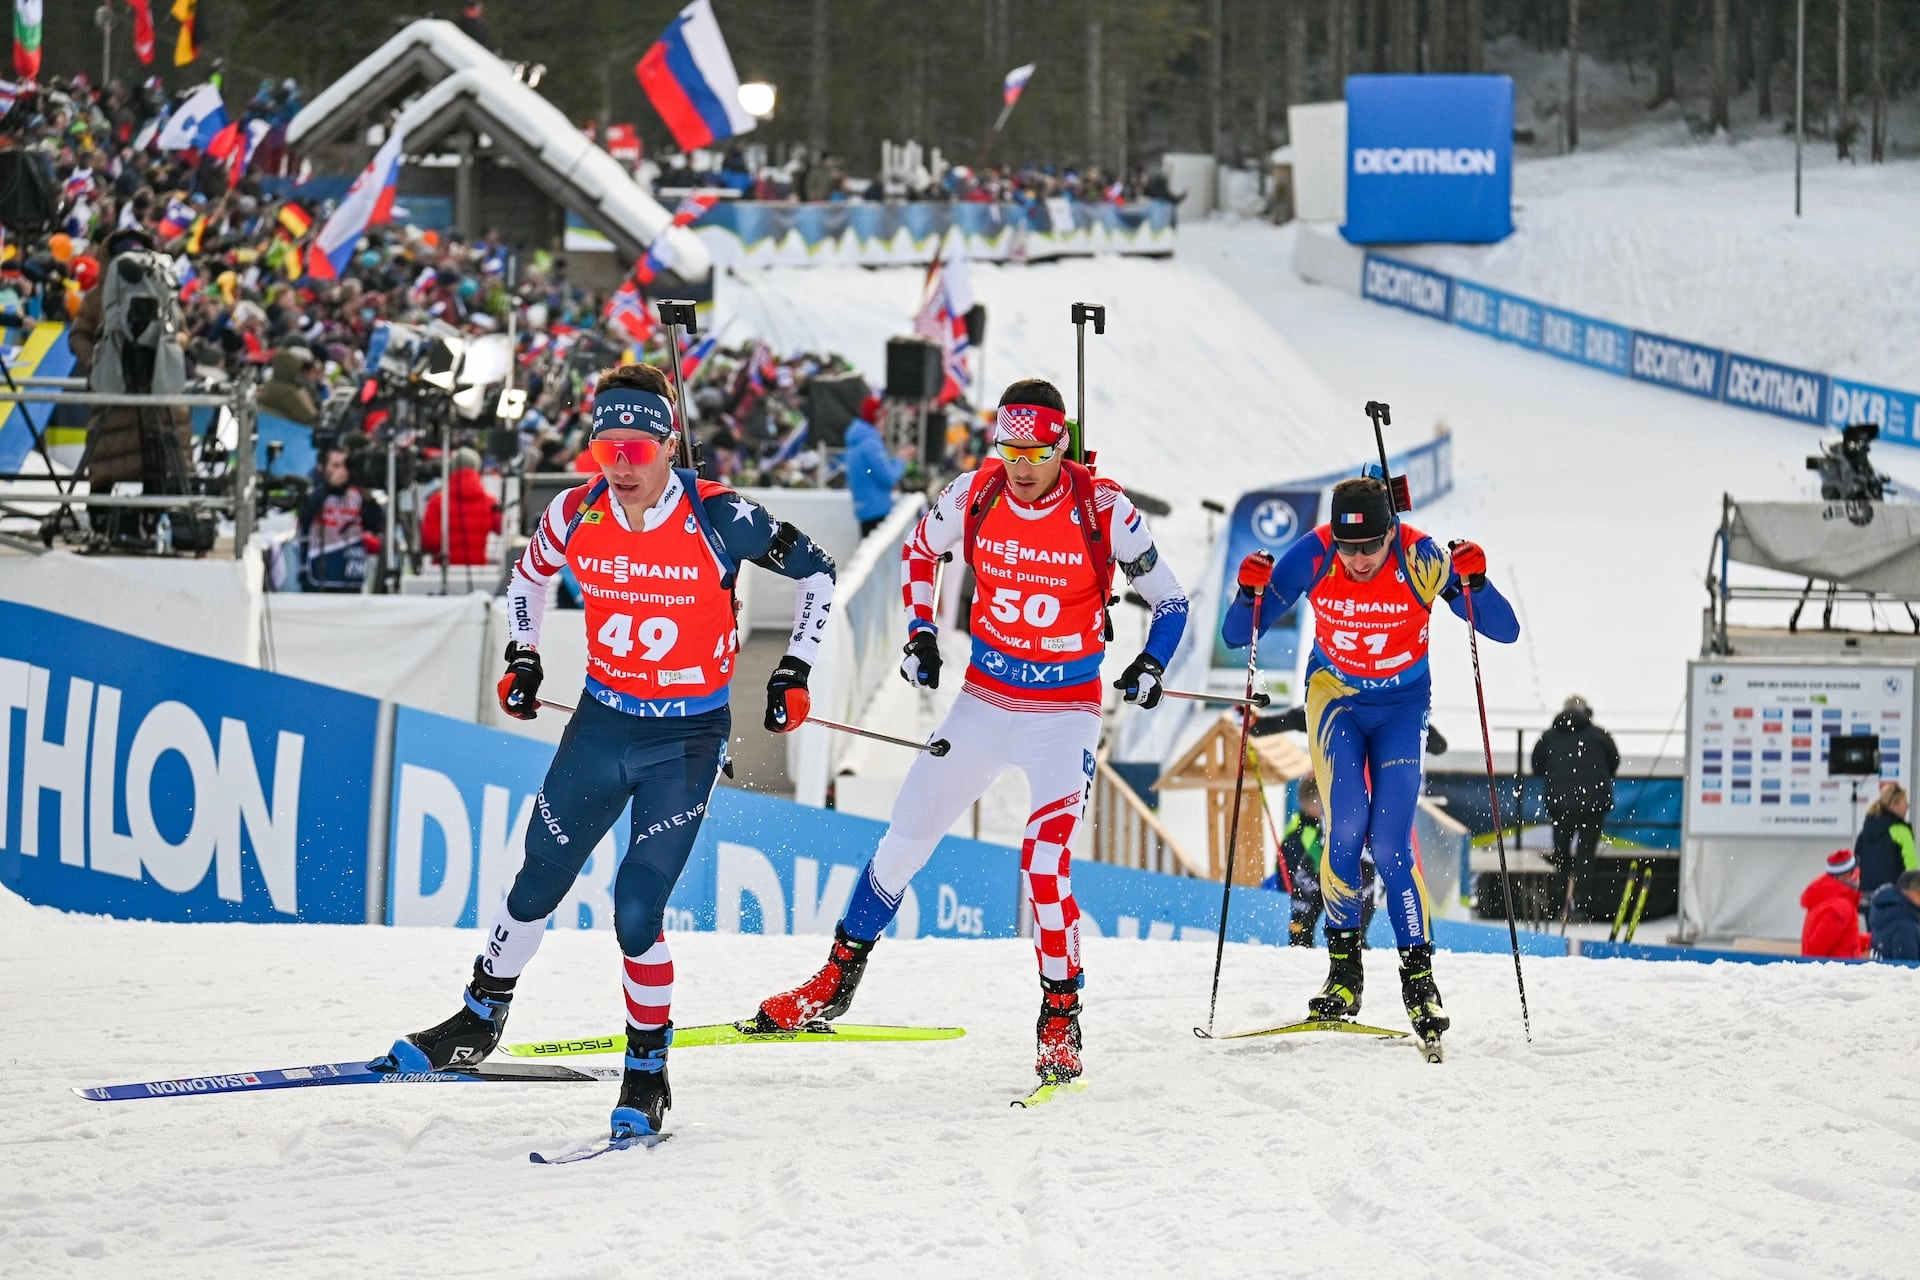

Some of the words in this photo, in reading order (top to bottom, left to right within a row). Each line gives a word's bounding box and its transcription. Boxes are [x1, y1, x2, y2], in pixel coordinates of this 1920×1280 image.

[1354, 148, 1496, 175] DECATHLON
[1366, 258, 1448, 314] DECATHLON
[1633, 337, 1716, 392] DECATHLON
[1726, 359, 1820, 418] DECATHLON
[604, 403, 661, 418] ARIENS
[1832, 384, 1887, 431] DKB
[975, 536, 1083, 566] VIESSMANN
[577, 555, 699, 584] VIESSMANN
[982, 561, 1013, 580] Heat
[1016, 571, 1068, 588] pumps
[580, 581, 696, 607] Wärmepumpen
[989, 587, 1060, 628] 50
[1316, 597, 1409, 617] VIESSMANN
[597, 612, 679, 662] 49
[1331, 629, 1389, 655] 51
[1021, 663, 1064, 683] iX1
[635, 802, 706, 845] ARIENS
[937, 883, 984, 936] Das
[1402, 888, 1420, 938] ROMANIA
[484, 924, 509, 974] USA
[534, 1038, 613, 1054] FISCHER
[145, 1074, 246, 1096] SALOMON
[379, 1073, 444, 1083] SALOMON
